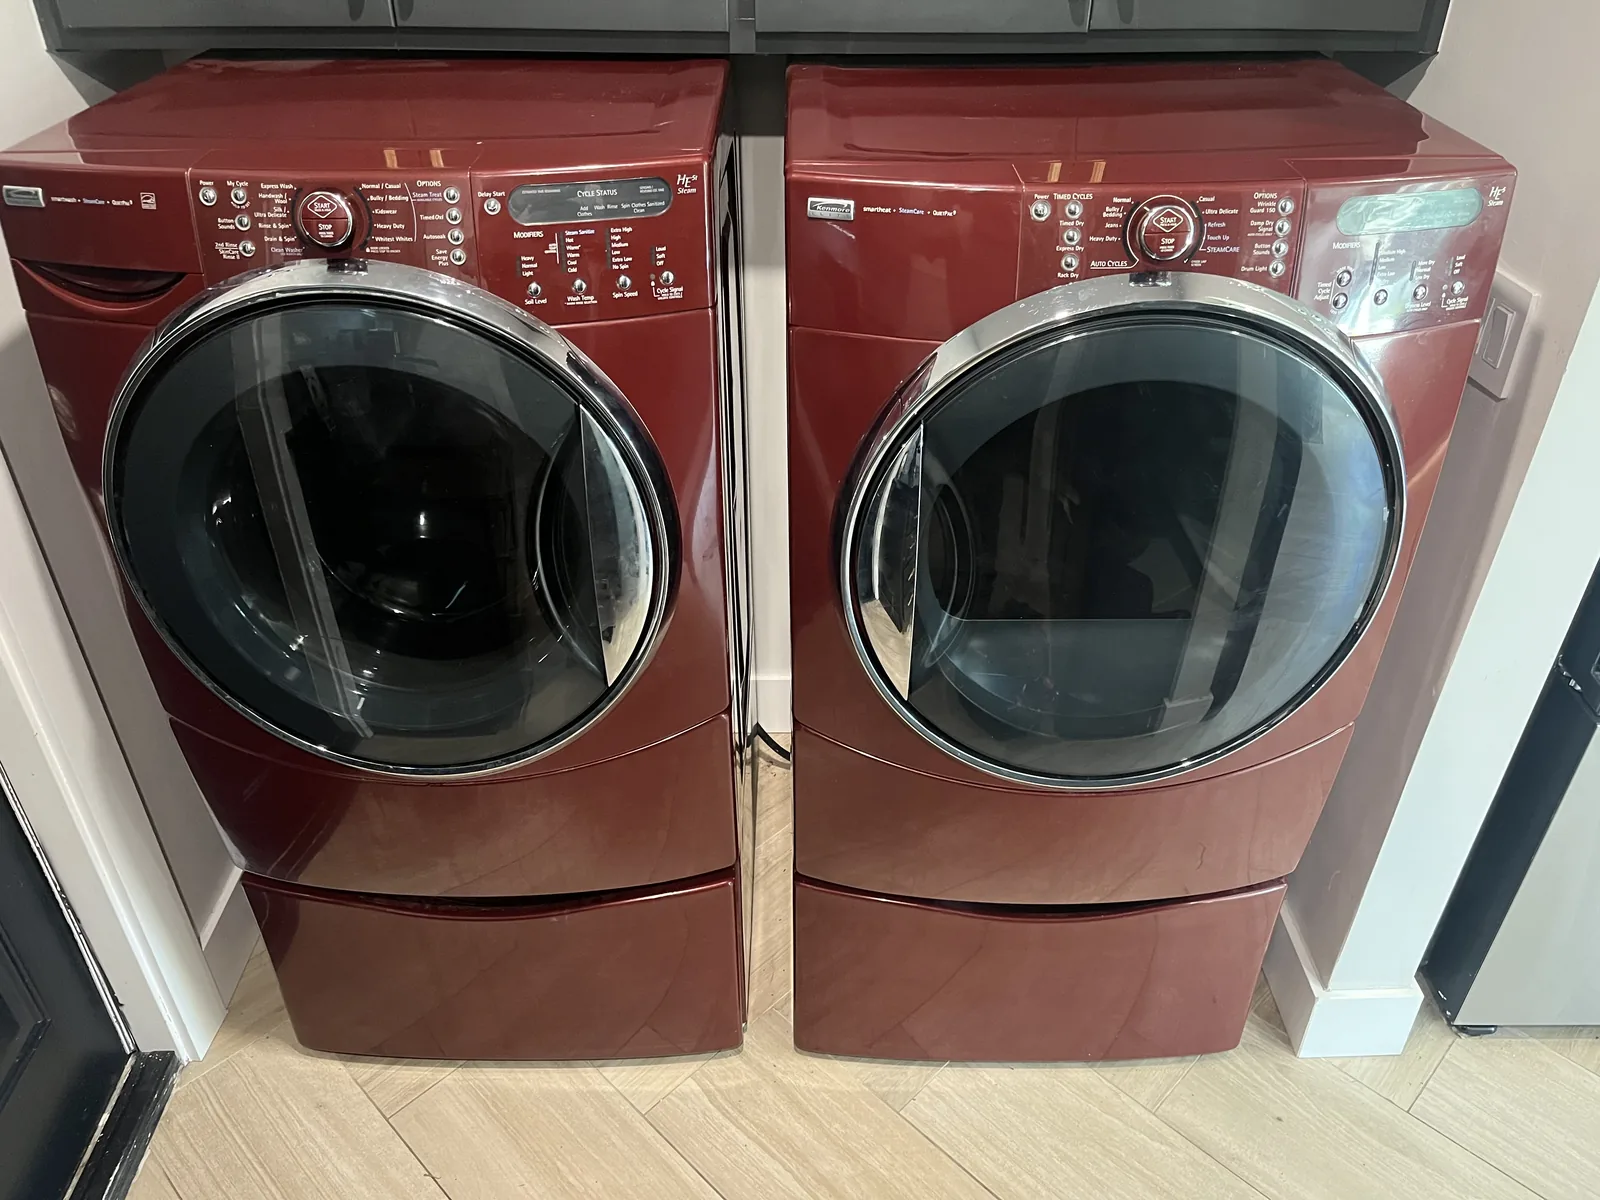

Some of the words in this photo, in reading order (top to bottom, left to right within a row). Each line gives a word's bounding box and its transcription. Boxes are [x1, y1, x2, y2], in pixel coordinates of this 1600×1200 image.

[816, 204, 850, 214] Kenmore
[898, 207, 924, 215] SteamCare
[514, 230, 544, 238] MODIFIERS
[1160, 237, 1176, 245] STOP
[1332, 242, 1360, 250] MODIFIERS
[624, 291, 638, 299] Speed
